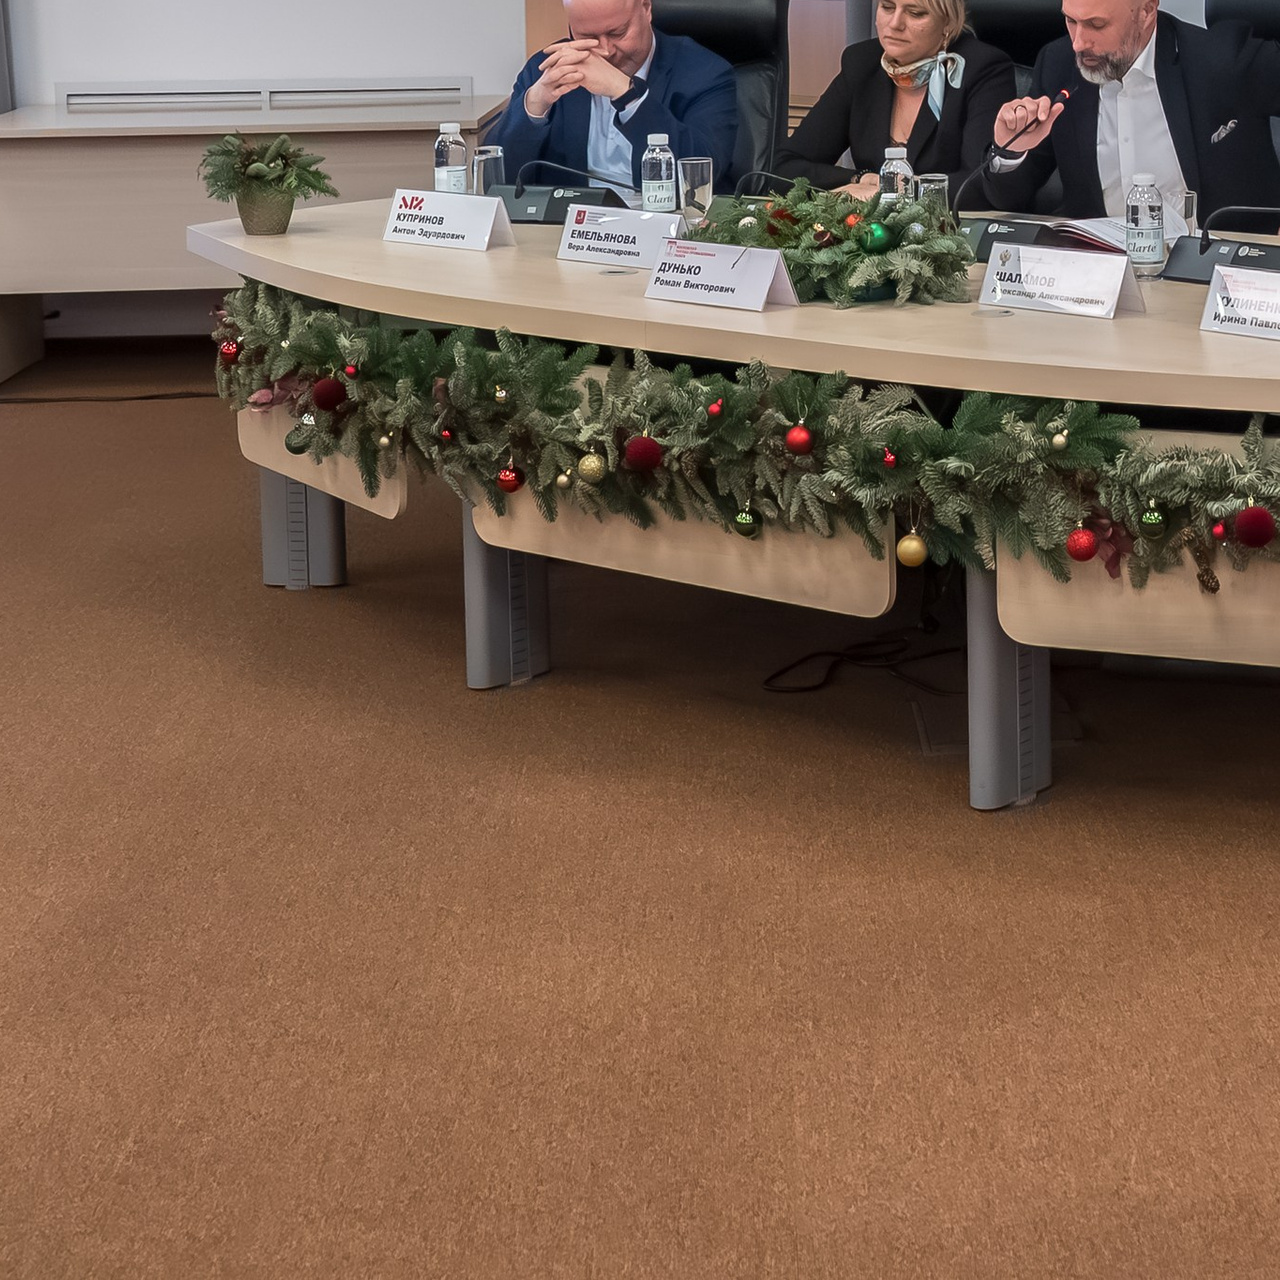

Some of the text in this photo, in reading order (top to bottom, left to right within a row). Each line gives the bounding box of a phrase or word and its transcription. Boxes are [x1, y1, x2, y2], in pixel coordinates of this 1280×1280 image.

[396, 212, 445, 226] КУПРИНОВ
[392, 226, 417, 236] Антон
[570, 229, 637, 245] ЕМЕЛЬЯНОВА
[567, 242, 641, 257] Вера Александровна
[657, 262, 702, 276] ДУНЬКО
[654, 277, 736, 294] Роман Викторович
[996, 271, 1056, 288] ШАЛАМОВ
[991, 286, 1106, 306] Аександр Александрович
[1213, 311, 1247, 325] Ирина
